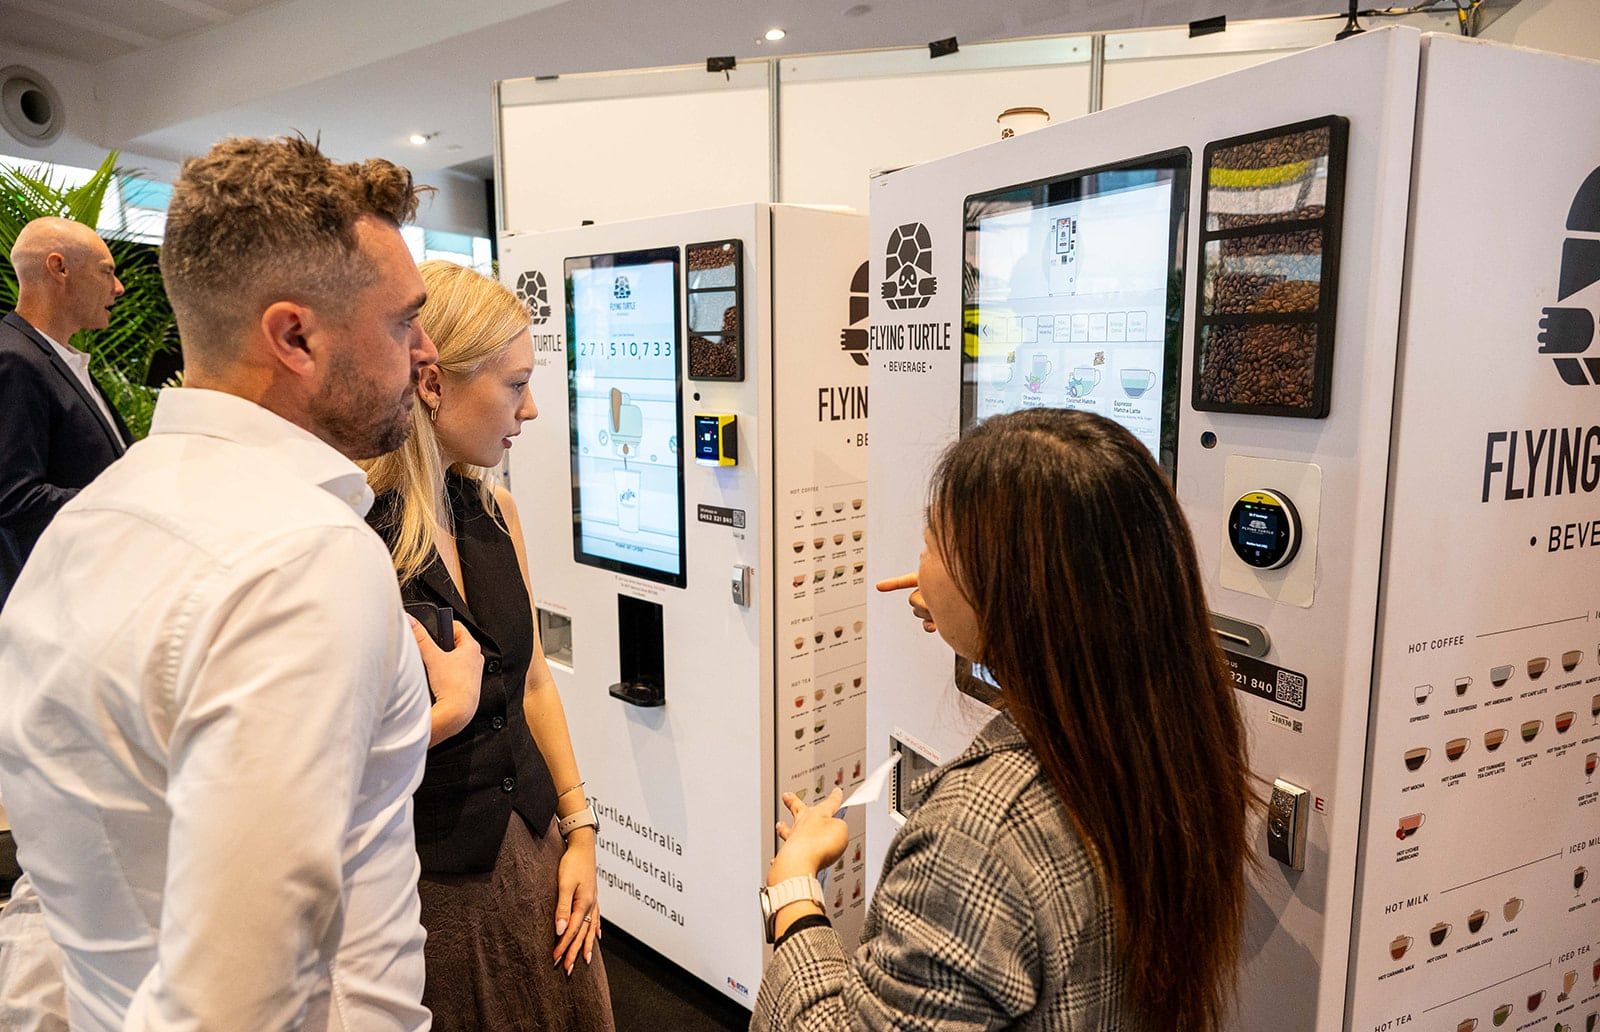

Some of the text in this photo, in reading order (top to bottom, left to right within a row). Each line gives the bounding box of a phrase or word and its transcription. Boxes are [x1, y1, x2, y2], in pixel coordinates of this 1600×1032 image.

[533, 334, 562, 352] TURTLE
[869, 321, 952, 352] FLYING TURTLE
[888, 361, 927, 374] BEVERAGE
[818, 385, 869, 423] FLYIN
[856, 432, 869, 447] BE
[1481, 425, 1600, 503] FLYING
[1547, 520, 1600, 553] BEVE
[1408, 635, 1465, 654] HOT COFFEE
[1229, 670, 1273, 694] 321 840
[1315, 797, 1325, 811] E
[1569, 836, 1600, 854] ICED MIL
[1385, 893, 1429, 915] HOT MILK
[1558, 945, 1590, 964] ICED TEA
[1373, 1014, 1412, 1032] HOT TEA
